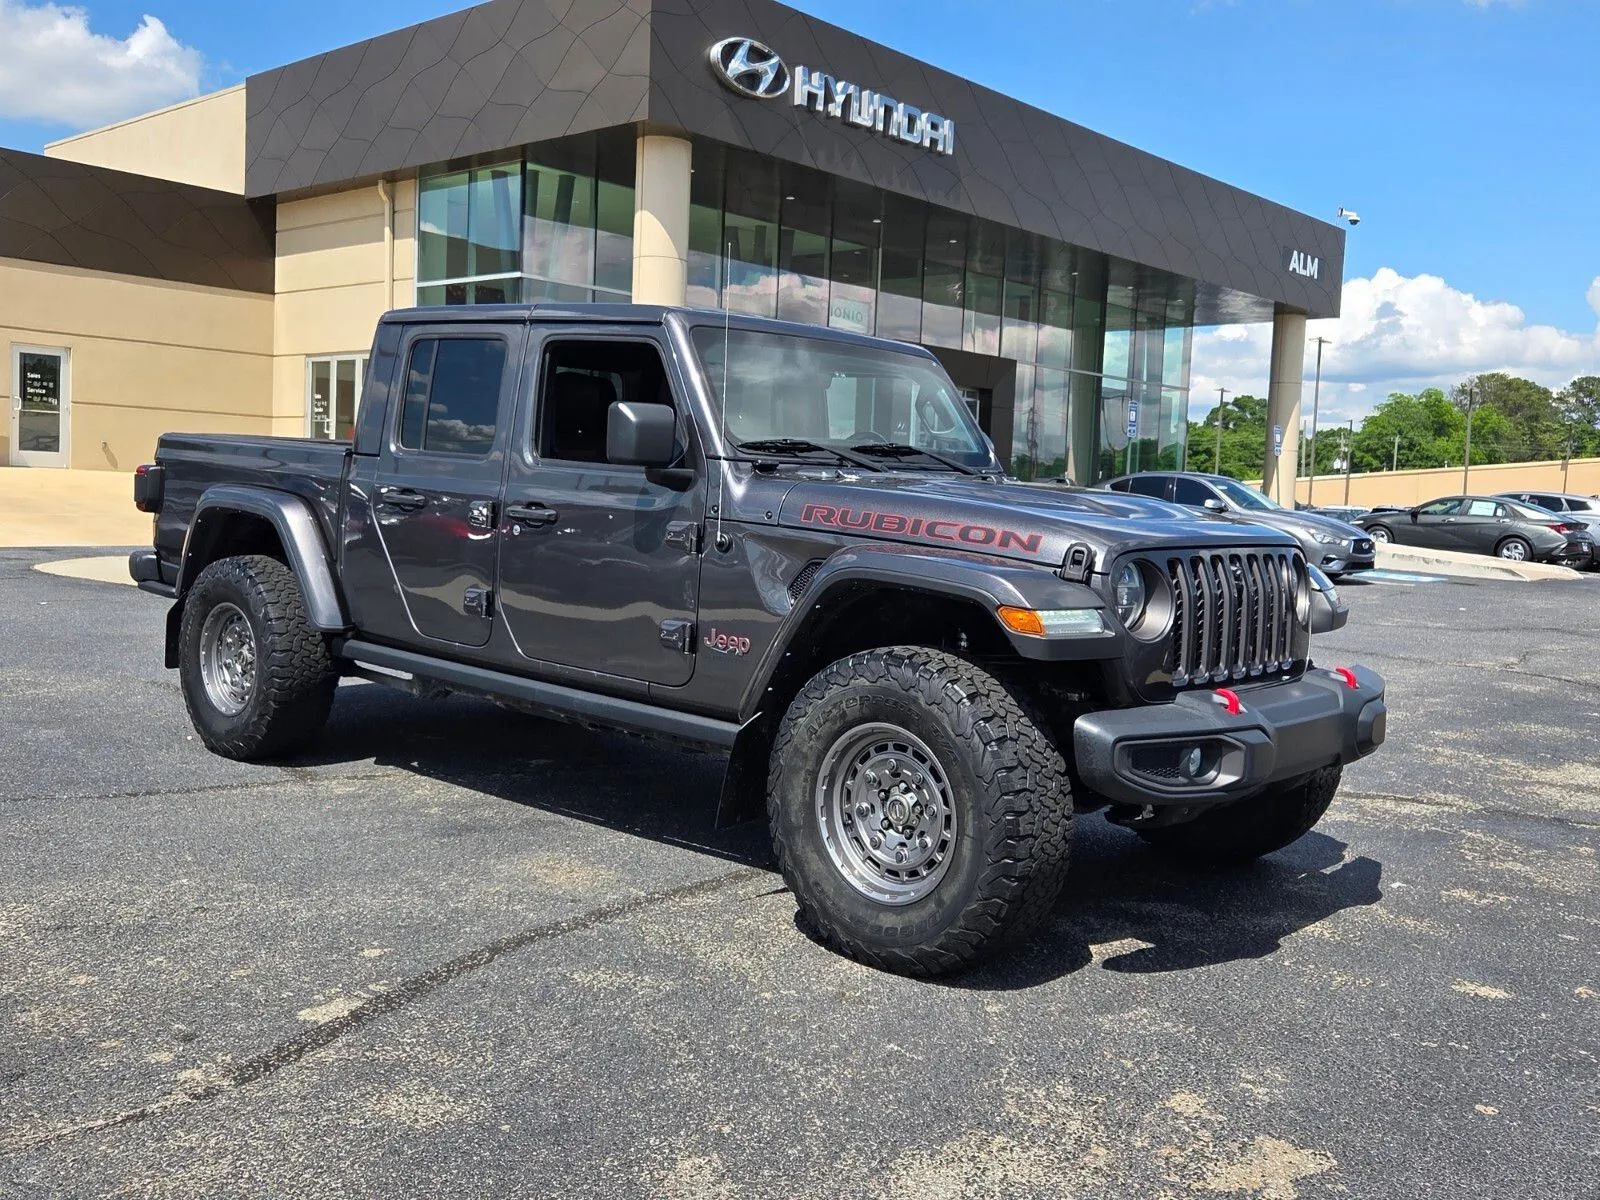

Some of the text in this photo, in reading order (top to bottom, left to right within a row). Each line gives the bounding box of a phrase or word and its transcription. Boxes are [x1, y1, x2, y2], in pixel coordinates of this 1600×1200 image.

[794, 65, 955, 155] HYUNDAI
[1289, 250, 1319, 279] ALM
[801, 503, 1042, 554] RUBICON
[703, 628, 750, 656] Jeep
